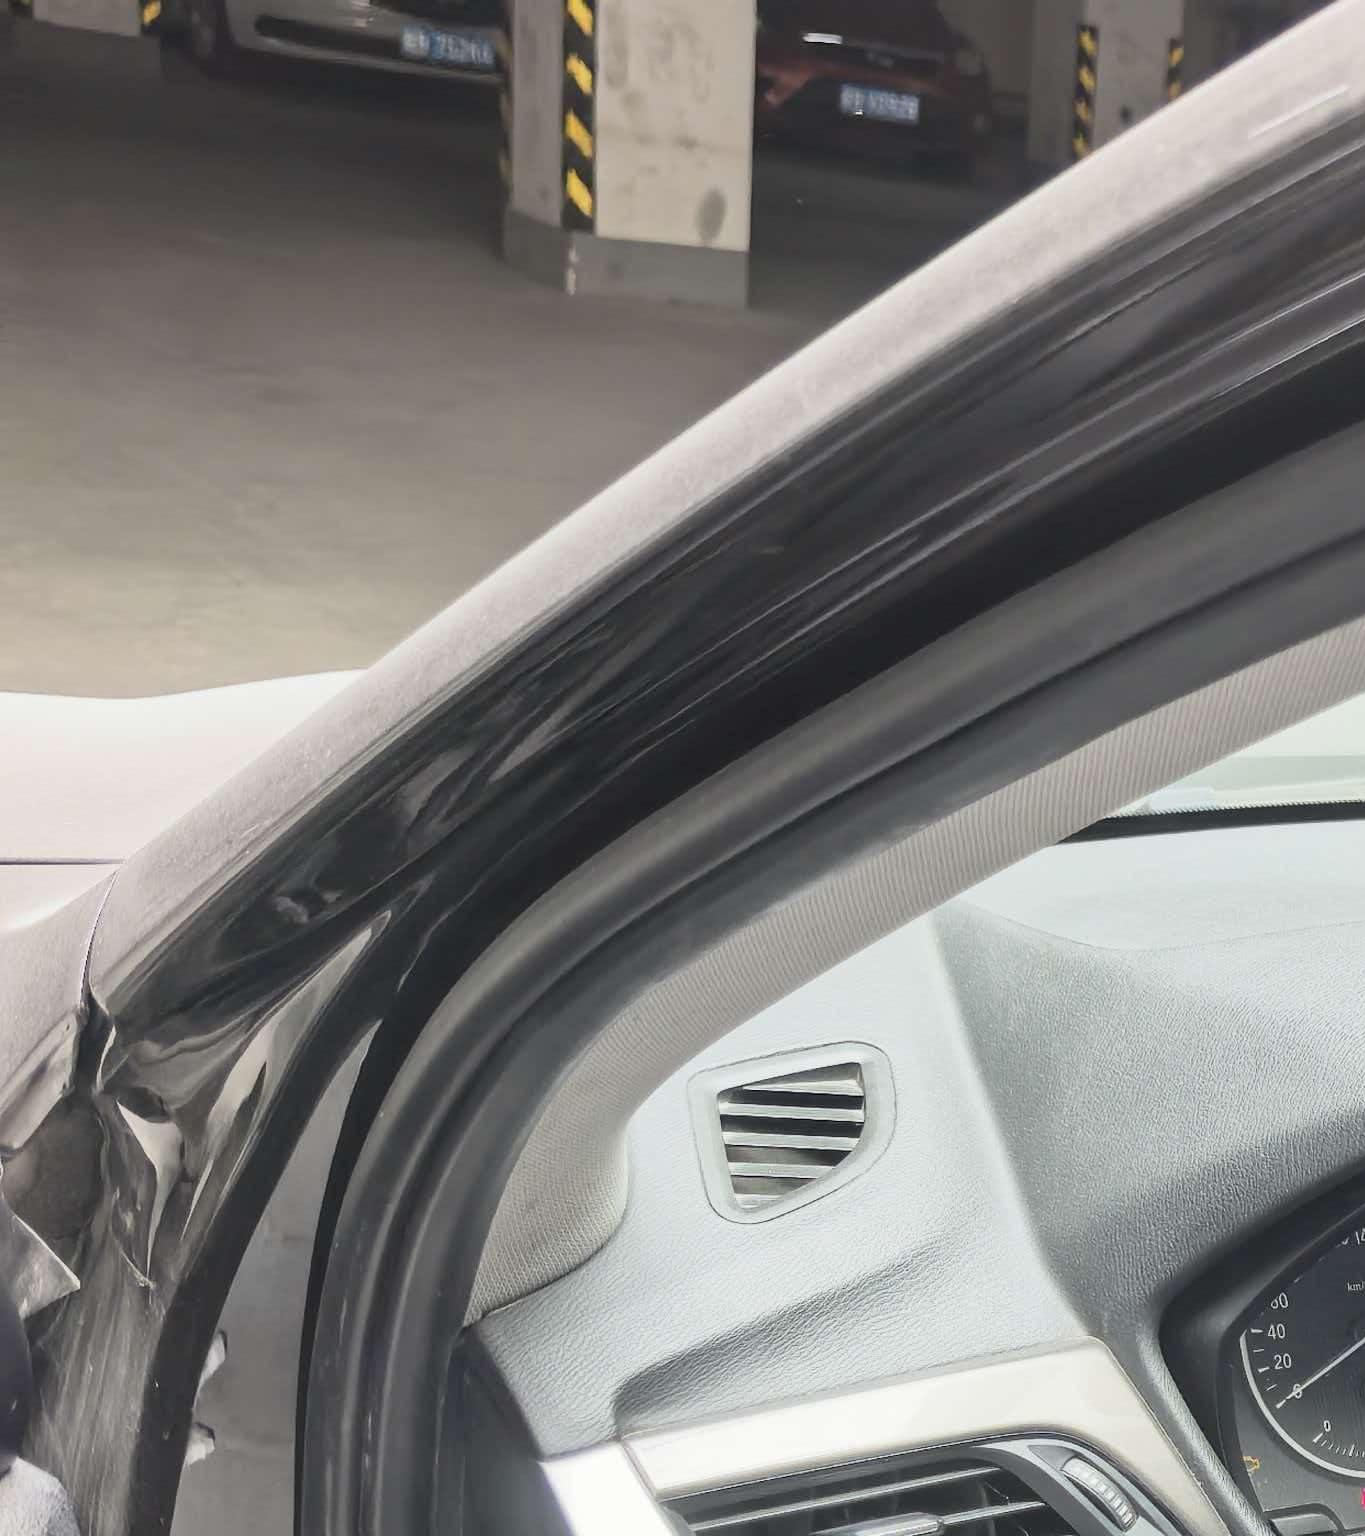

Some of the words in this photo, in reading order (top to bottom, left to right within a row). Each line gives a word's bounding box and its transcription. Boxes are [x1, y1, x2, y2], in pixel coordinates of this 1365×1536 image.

[1267, 1323, 1286, 1340] 40
[1273, 1353, 1292, 1370] 20
[1323, 1419, 1332, 1433] 0
